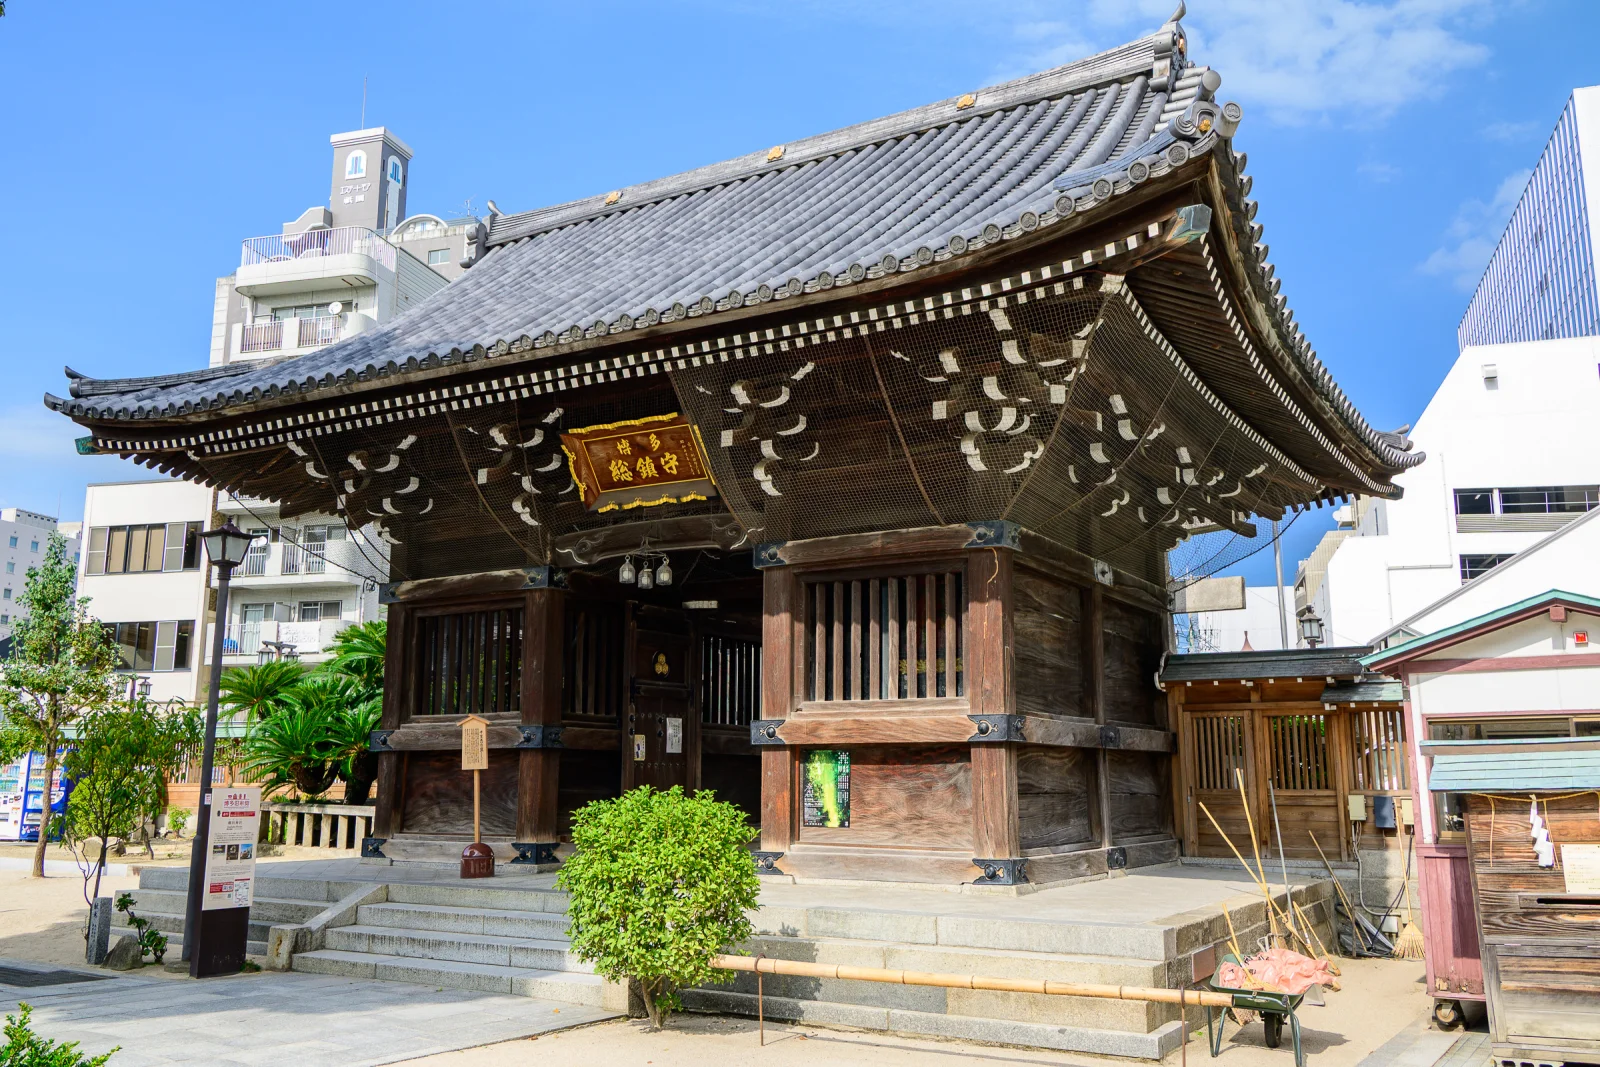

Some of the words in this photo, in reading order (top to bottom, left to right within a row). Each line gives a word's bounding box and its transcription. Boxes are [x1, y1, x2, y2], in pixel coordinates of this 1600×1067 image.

[616, 433, 661, 455] 博多
[608, 451, 680, 482] 総鎮守
